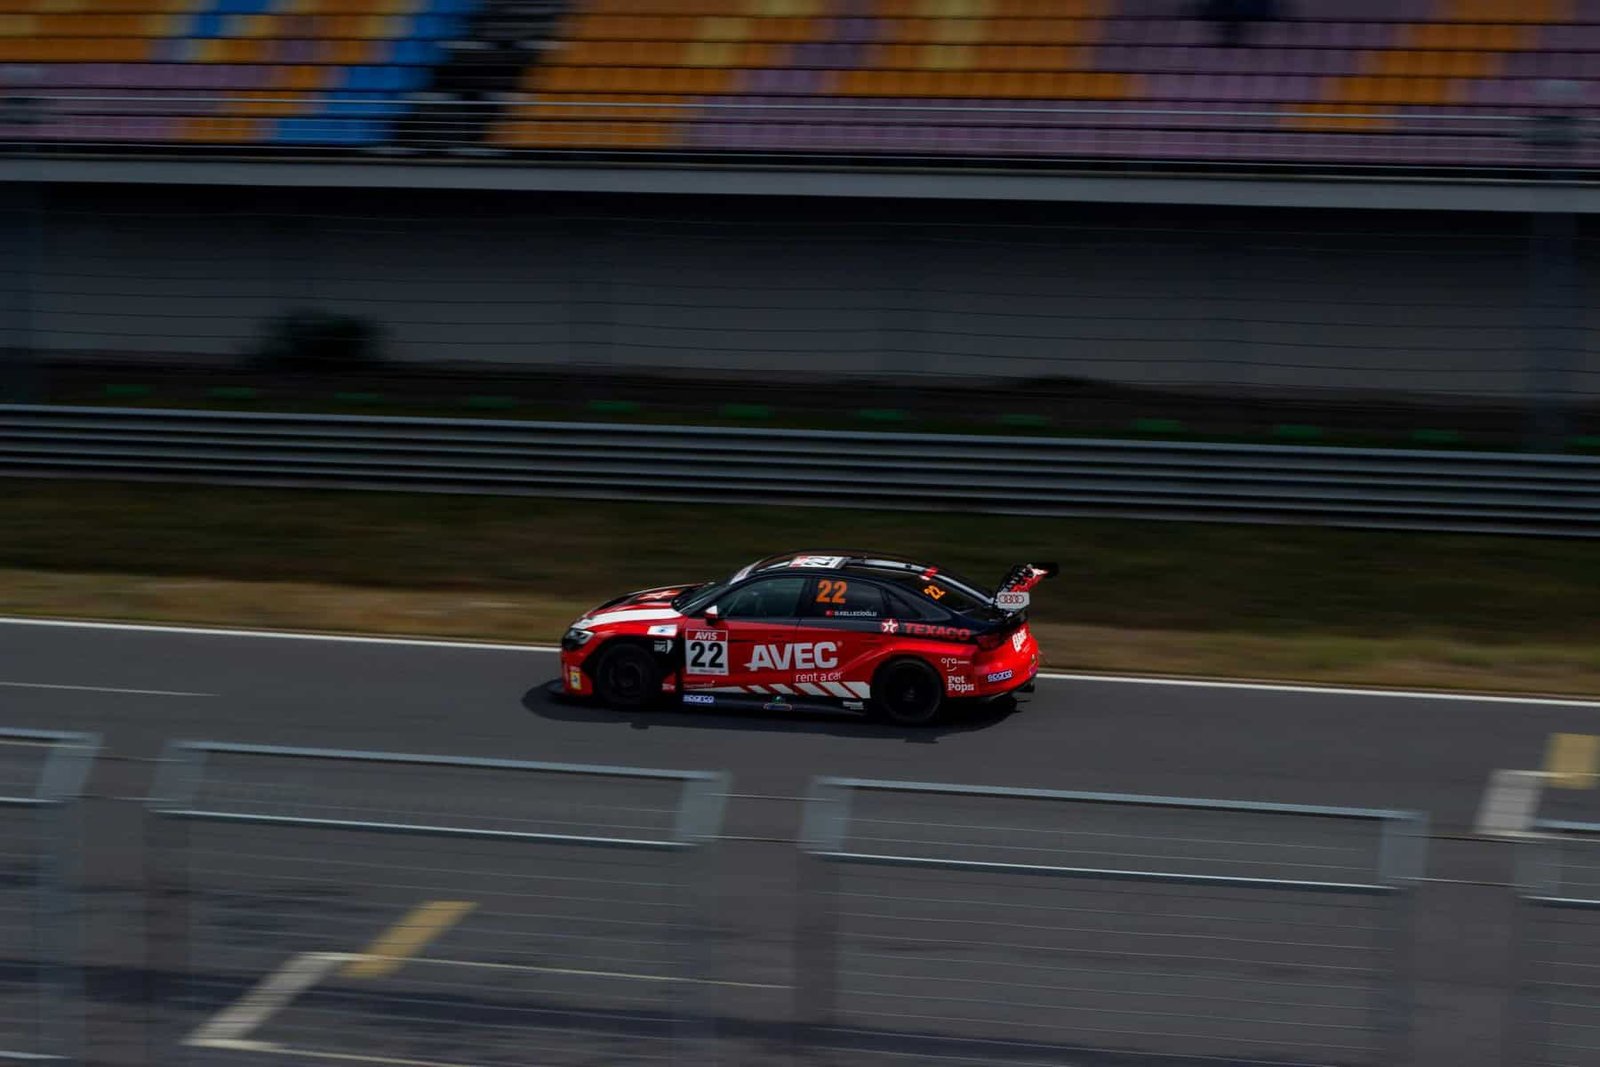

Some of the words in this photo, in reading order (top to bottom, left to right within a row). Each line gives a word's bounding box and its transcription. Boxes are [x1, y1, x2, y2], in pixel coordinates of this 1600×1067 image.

[816, 579, 847, 605] 22
[694, 631, 718, 640] AVIS
[904, 622, 971, 640] TEXACO
[690, 641, 723, 668] 22
[742, 641, 837, 672] AVEC
[795, 672, 817, 682] rent
[819, 673, 826, 682] a
[828, 671, 841, 680] car
[947, 675, 964, 684] Pet
[947, 683, 975, 693] Pops
